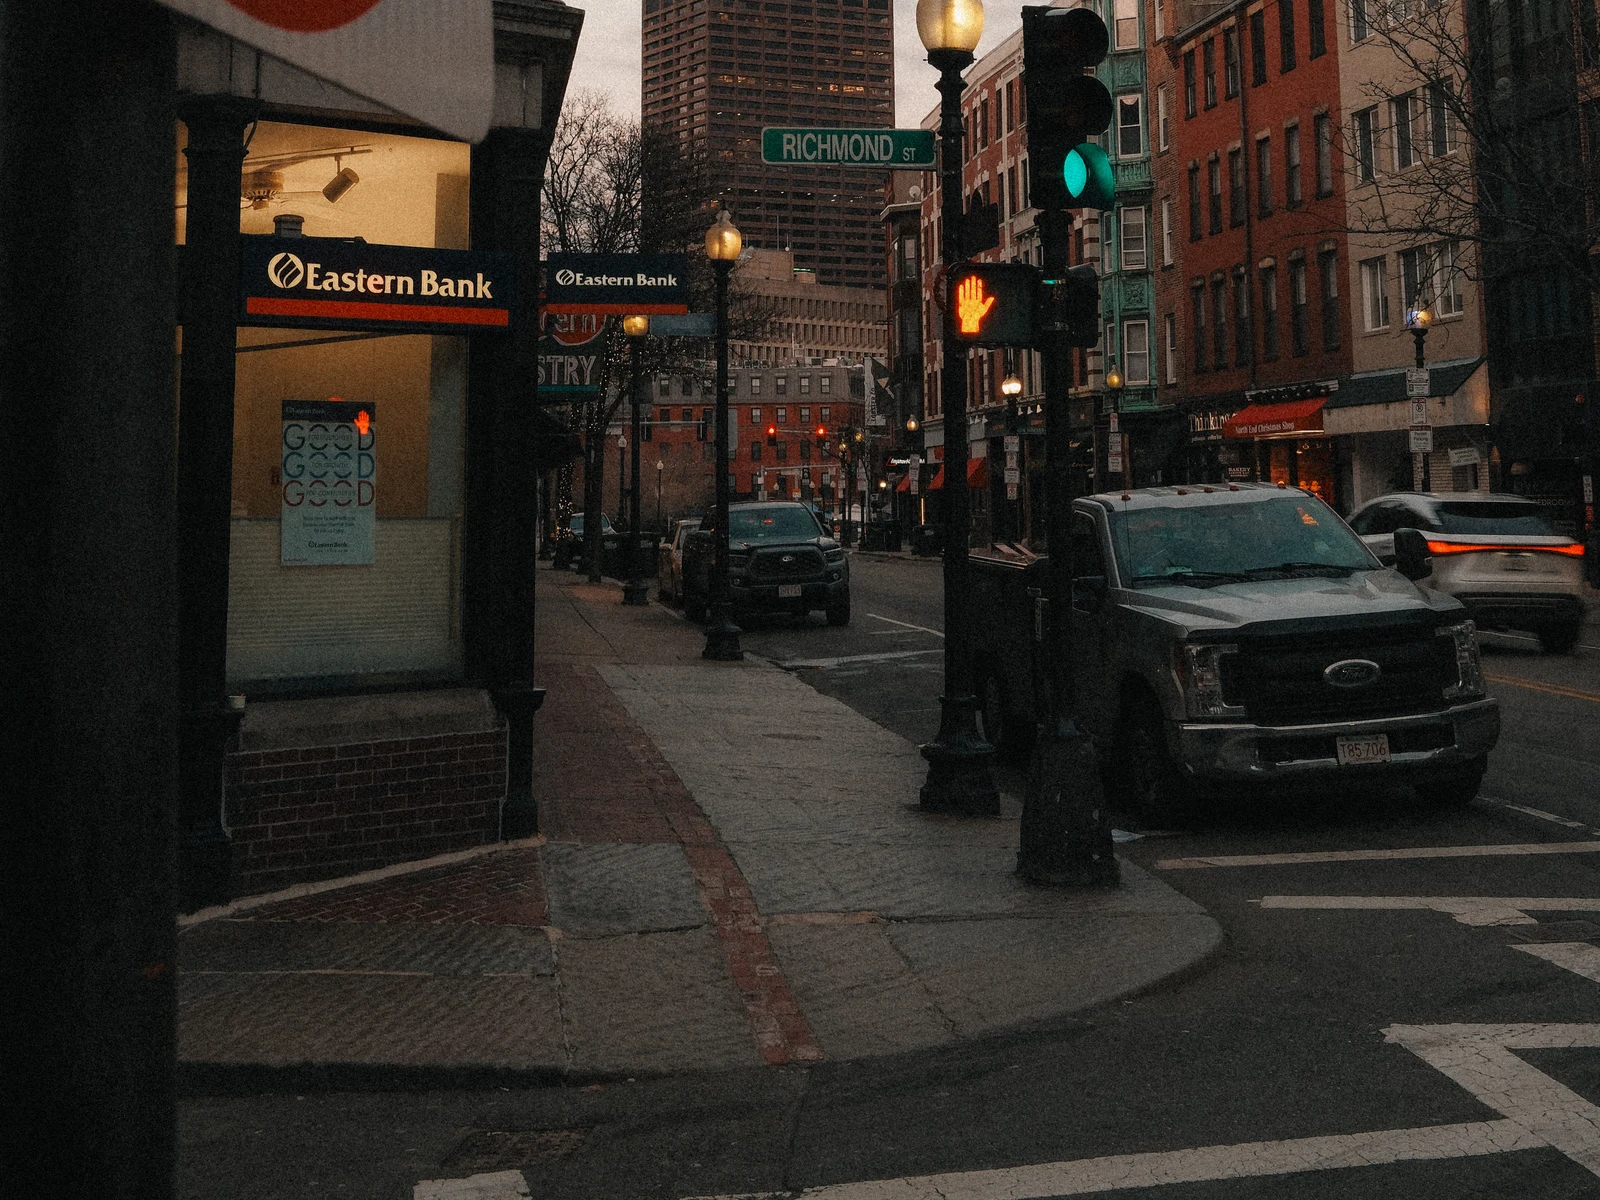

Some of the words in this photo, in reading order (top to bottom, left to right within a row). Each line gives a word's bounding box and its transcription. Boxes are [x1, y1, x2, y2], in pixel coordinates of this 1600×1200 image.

[782, 133, 894, 161] RICHMOND
[902, 147, 916, 161] ST
[306, 262, 414, 295] Eastern
[420, 269, 493, 299] Bank
[575, 272, 634, 287] Eastern
[636, 273, 678, 287] Bank
[540, 311, 597, 334] ern
[1258, 423, 1282, 433] Christmas
[1282, 421, 1295, 431] Shop
[283, 452, 375, 479] GOOD
[282, 480, 375, 507] GOOD
